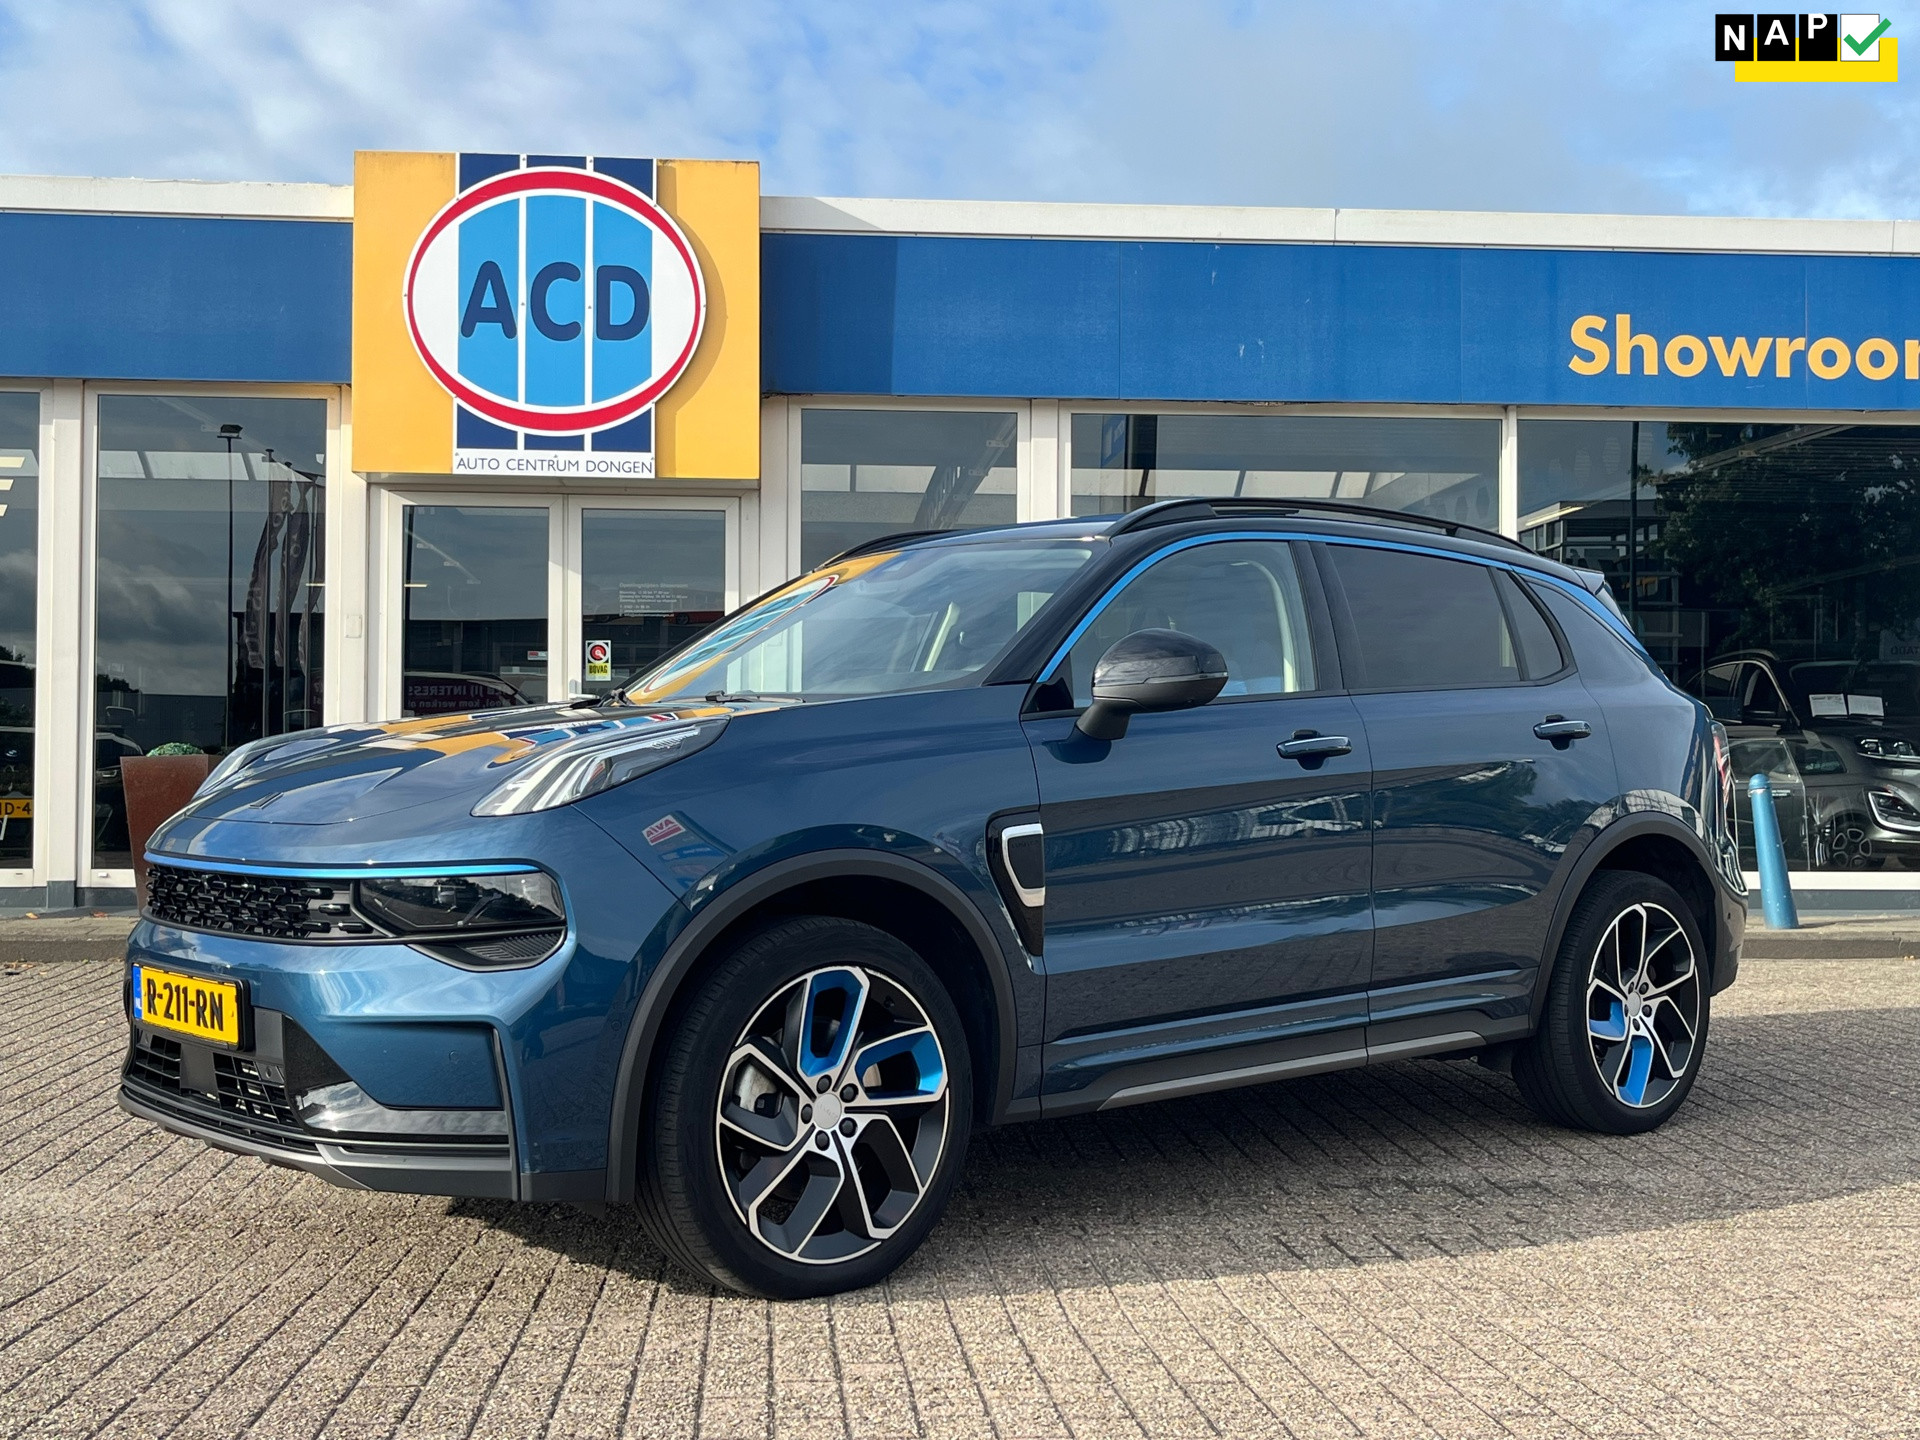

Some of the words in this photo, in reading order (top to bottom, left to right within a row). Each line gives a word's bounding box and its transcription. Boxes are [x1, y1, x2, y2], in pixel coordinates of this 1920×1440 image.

[460, 260, 650, 342] ACD
[1568, 313, 1920, 380] Showroo
[456, 457, 500, 470] AUTO
[506, 458, 580, 472] CENTRUM
[585, 460, 653, 474] DONGEN
[588, 664, 608, 674] BOVAG
[0, 801, 32, 816] D-4
[147, 977, 224, 1033] R-211-RN
